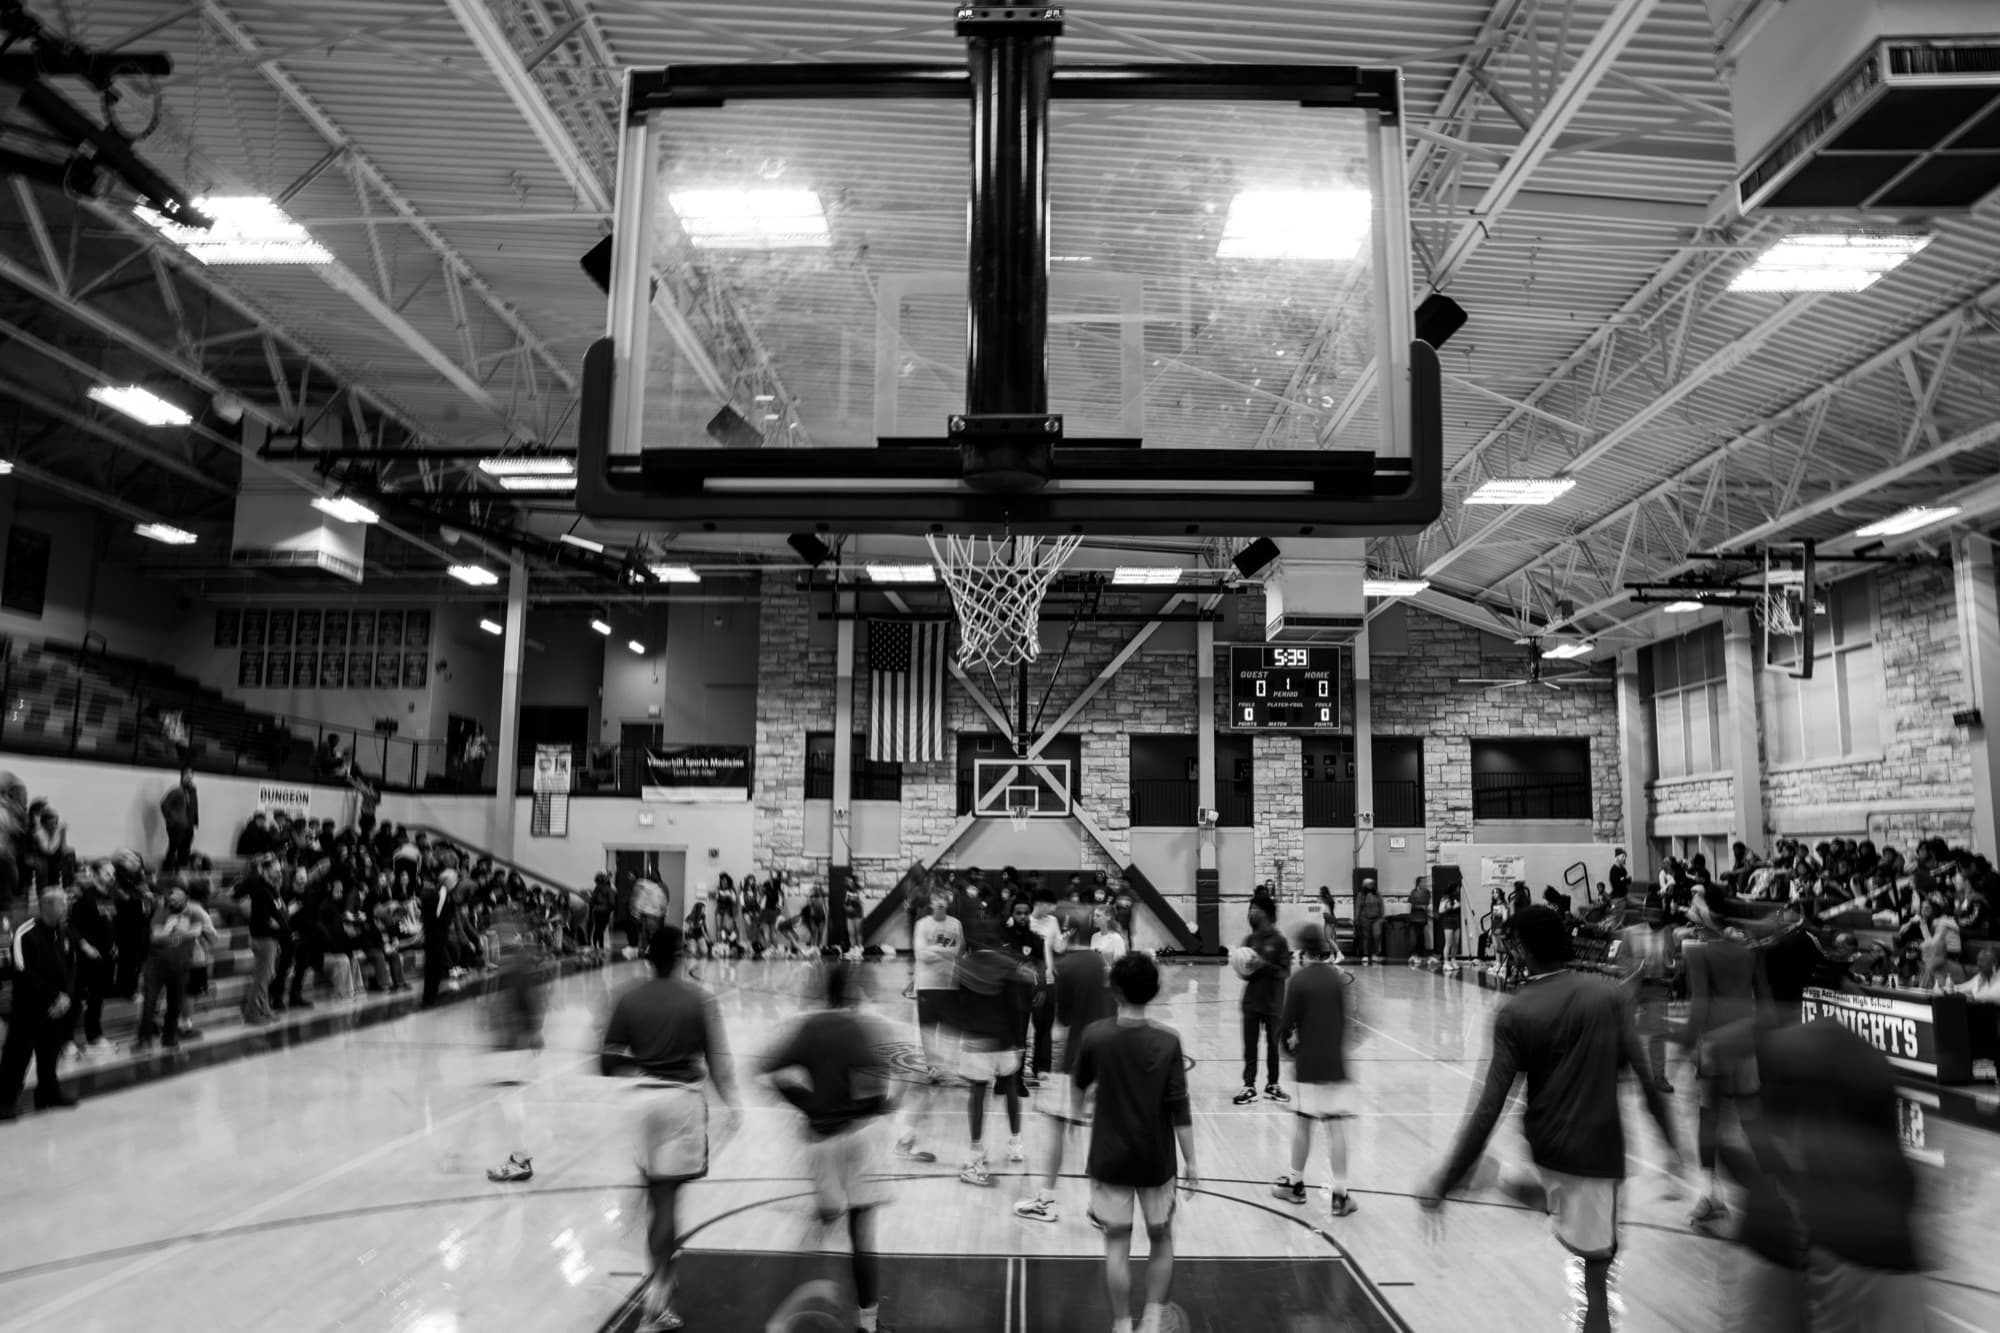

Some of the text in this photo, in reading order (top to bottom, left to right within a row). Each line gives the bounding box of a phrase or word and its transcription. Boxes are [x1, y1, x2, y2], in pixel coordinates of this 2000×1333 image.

[1274, 649, 1307, 666] 5:39
[1240, 671, 1269, 679] GUEST
[1304, 671, 1330, 679] HOME
[1256, 680, 1266, 697] 0
[1286, 677, 1290, 690] 1
[1318, 680, 1328, 697] 0
[1244, 707, 1254, 721] 0
[1320, 708, 1330, 722] 0
[685, 757, 709, 769] Sports
[710, 757, 744, 768] Medicine
[260, 787, 309, 806] DUNGEON
[1852, 994, 1869, 1009] High
